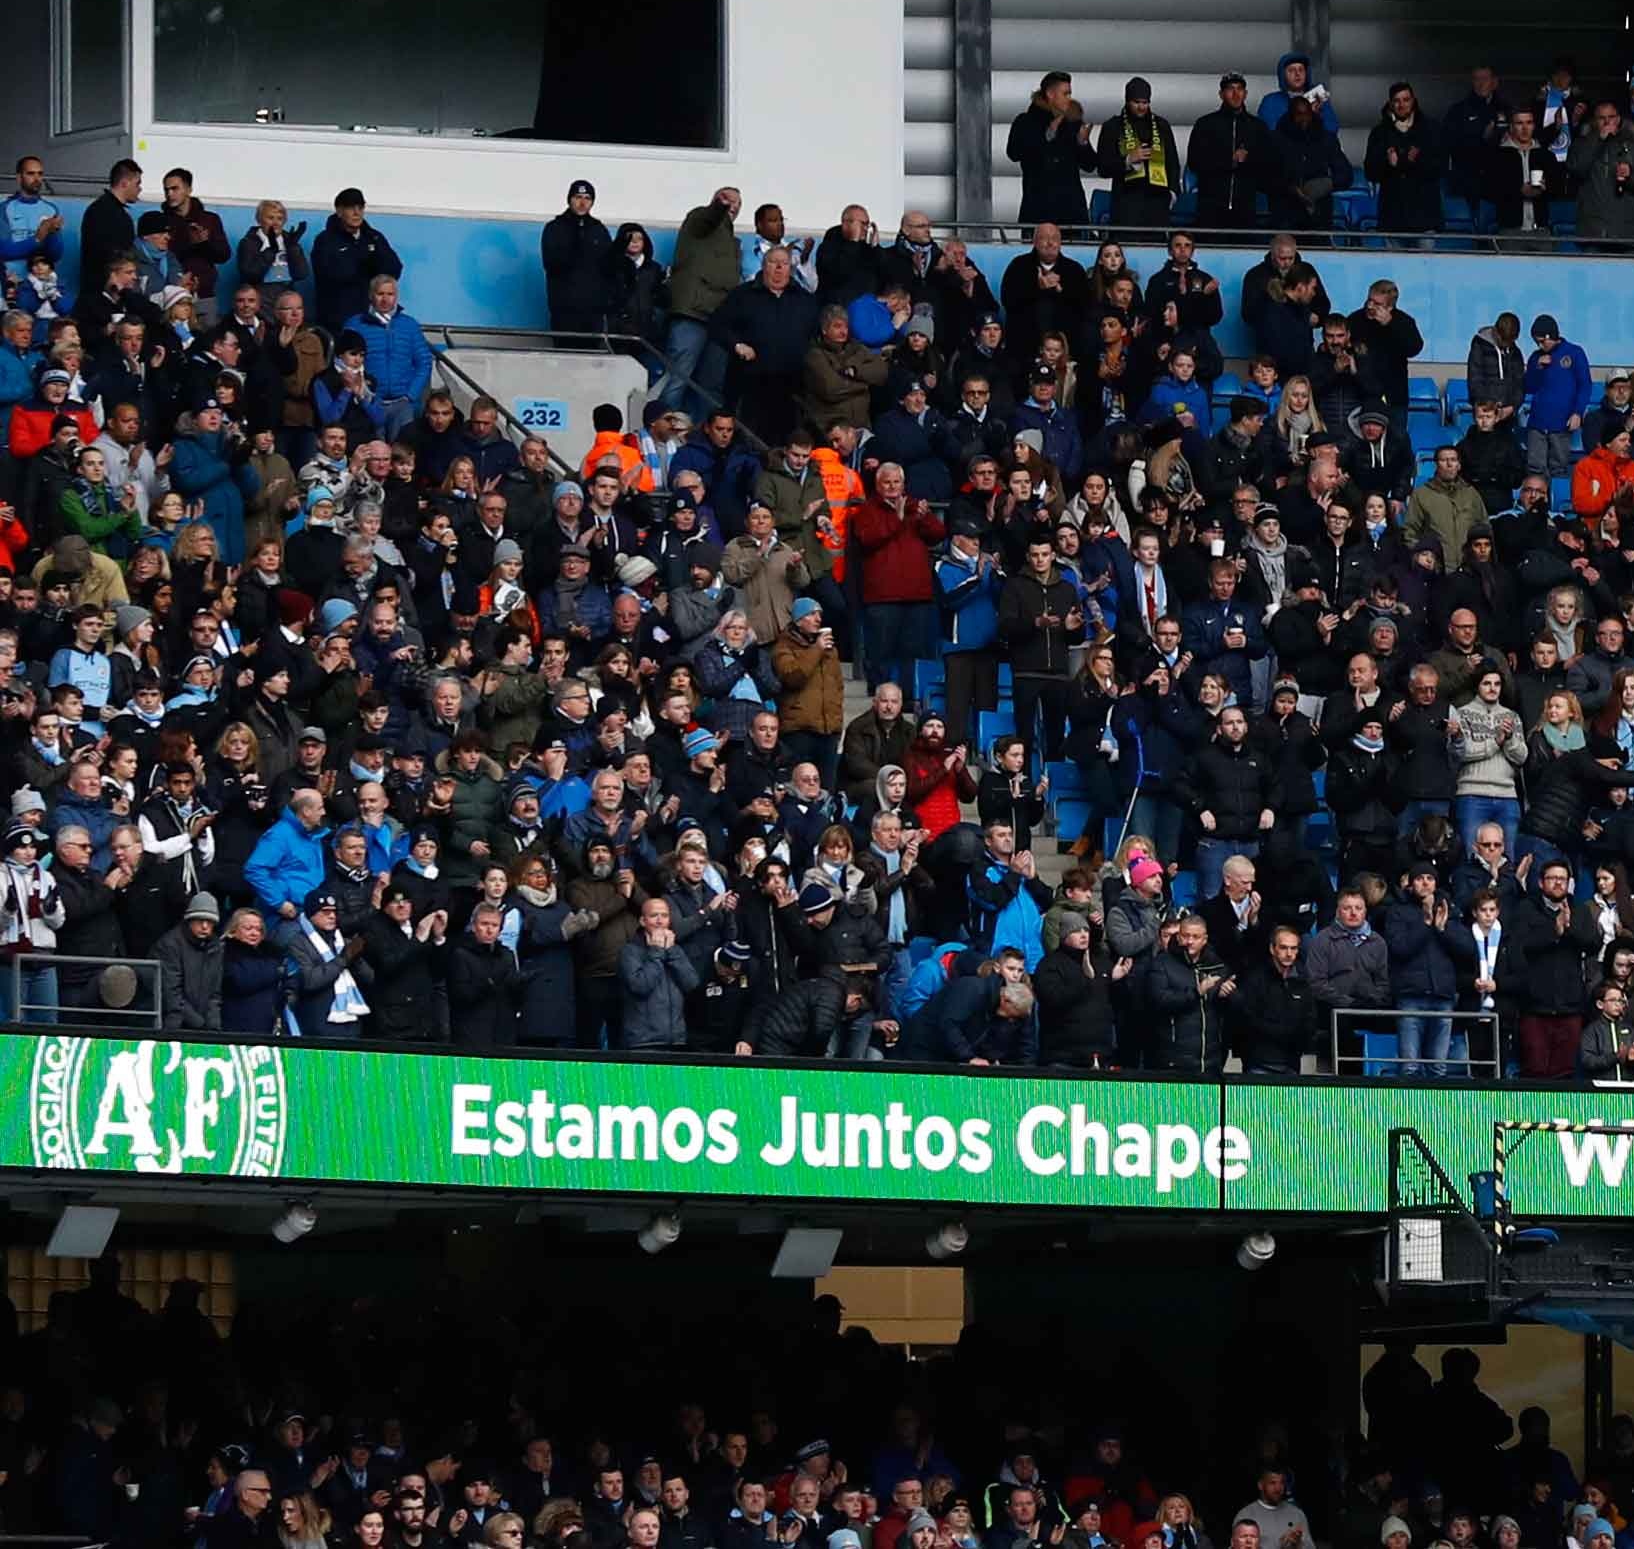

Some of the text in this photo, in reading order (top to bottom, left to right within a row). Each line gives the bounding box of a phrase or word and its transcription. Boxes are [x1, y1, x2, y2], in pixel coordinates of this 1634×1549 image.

[522, 409, 561, 426] 232
[452, 1083, 738, 1164] Estamos
[760, 1096, 993, 1173] Juntos
[1017, 1104, 1252, 1191] Chape
